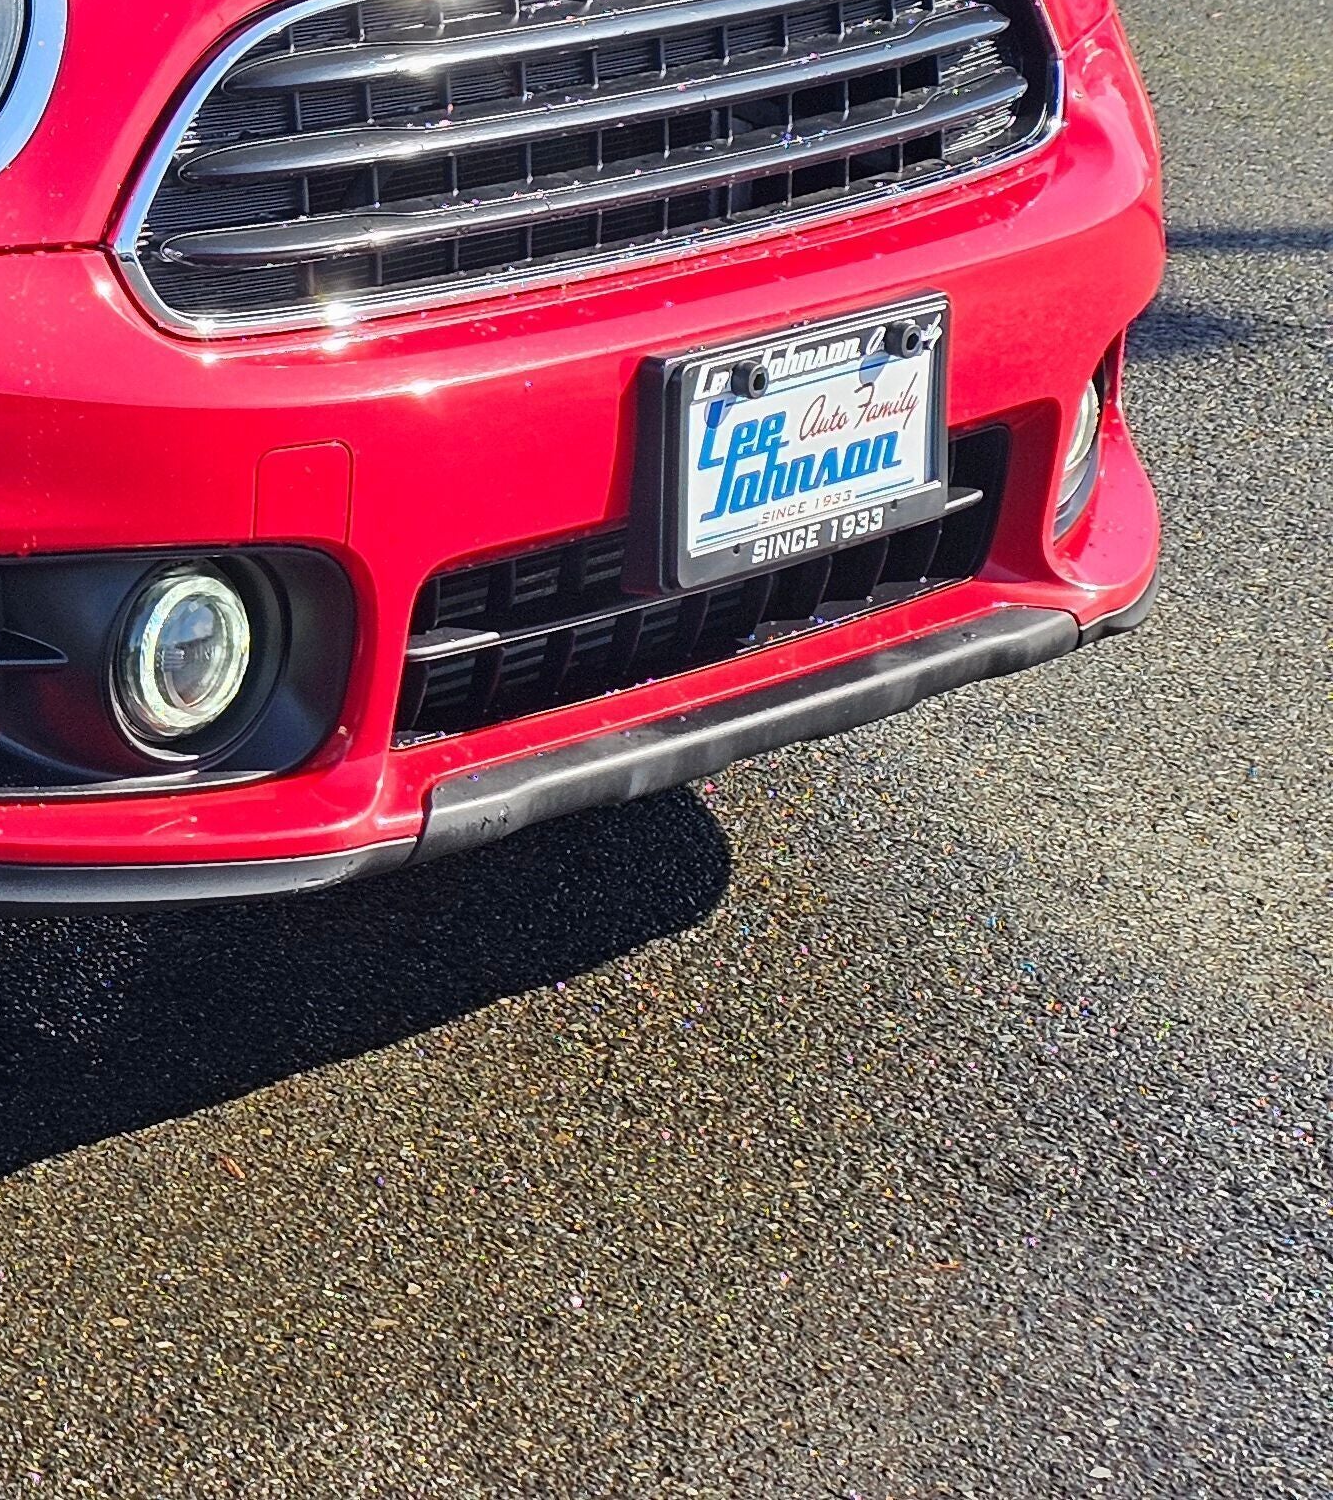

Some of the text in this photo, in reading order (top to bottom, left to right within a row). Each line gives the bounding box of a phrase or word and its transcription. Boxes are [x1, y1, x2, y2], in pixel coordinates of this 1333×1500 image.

[697, 401, 790, 470] Lee
[799, 372, 919, 442] Auto Family
[700, 430, 902, 522] Johnson
[762, 490, 853, 524] SINCE 1933
[751, 508, 884, 564] SINCE 1933
